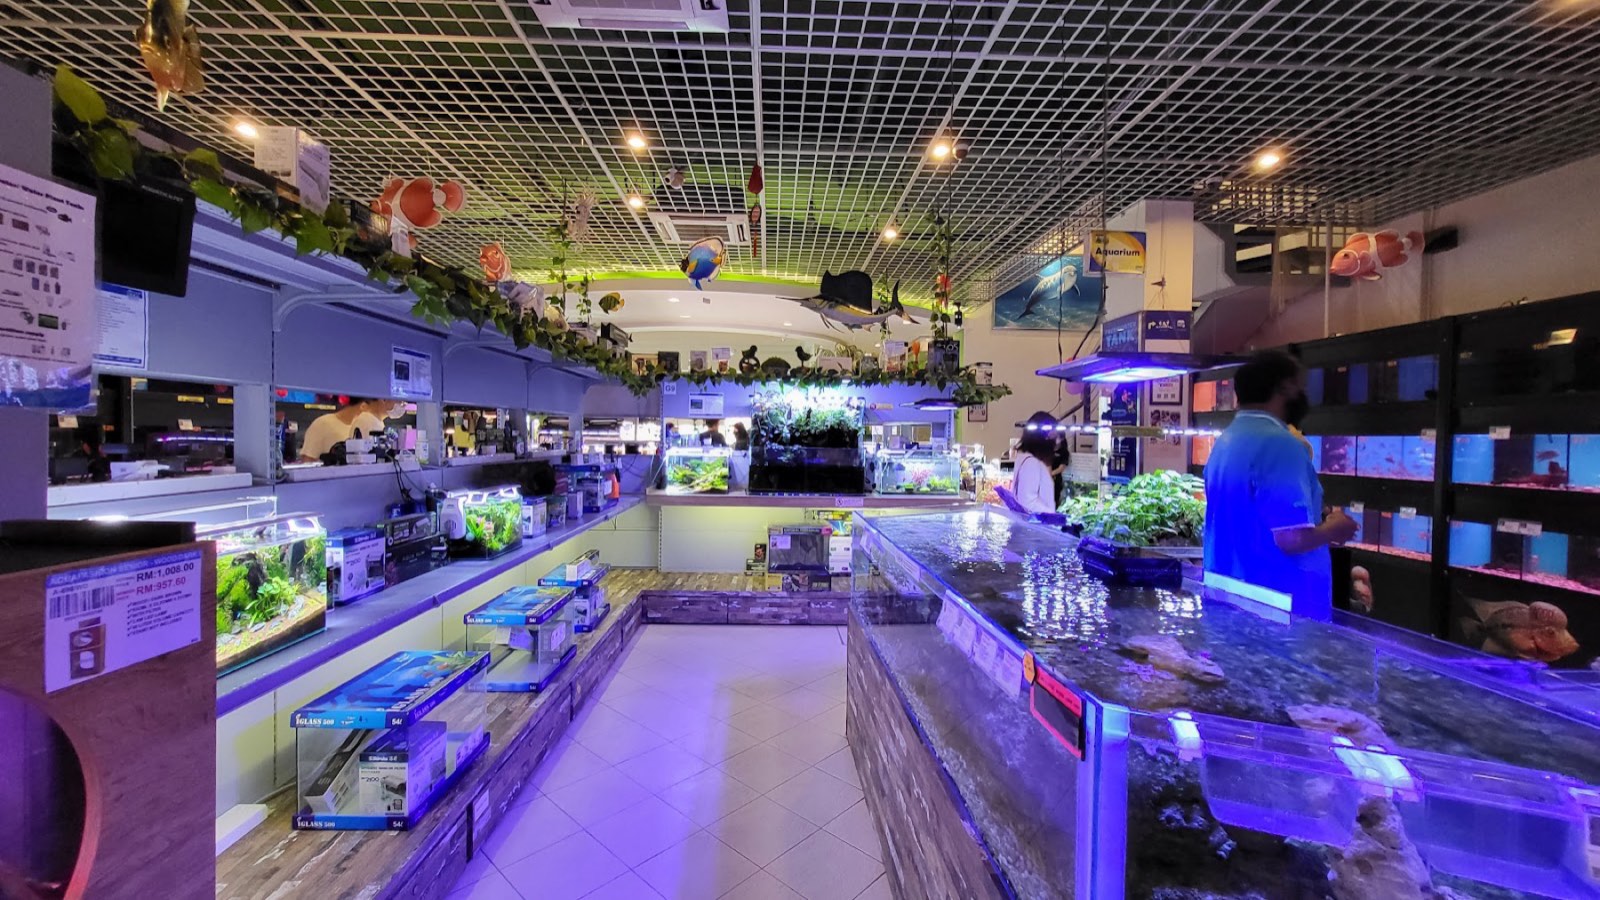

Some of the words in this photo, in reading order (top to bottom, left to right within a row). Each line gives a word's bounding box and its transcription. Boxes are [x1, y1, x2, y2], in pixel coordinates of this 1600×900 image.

[1095, 247, 1140, 257] Aquarium
[136, 562, 195, 582] RM:1,008.00
[136, 576, 187, 595] RM:957.60
